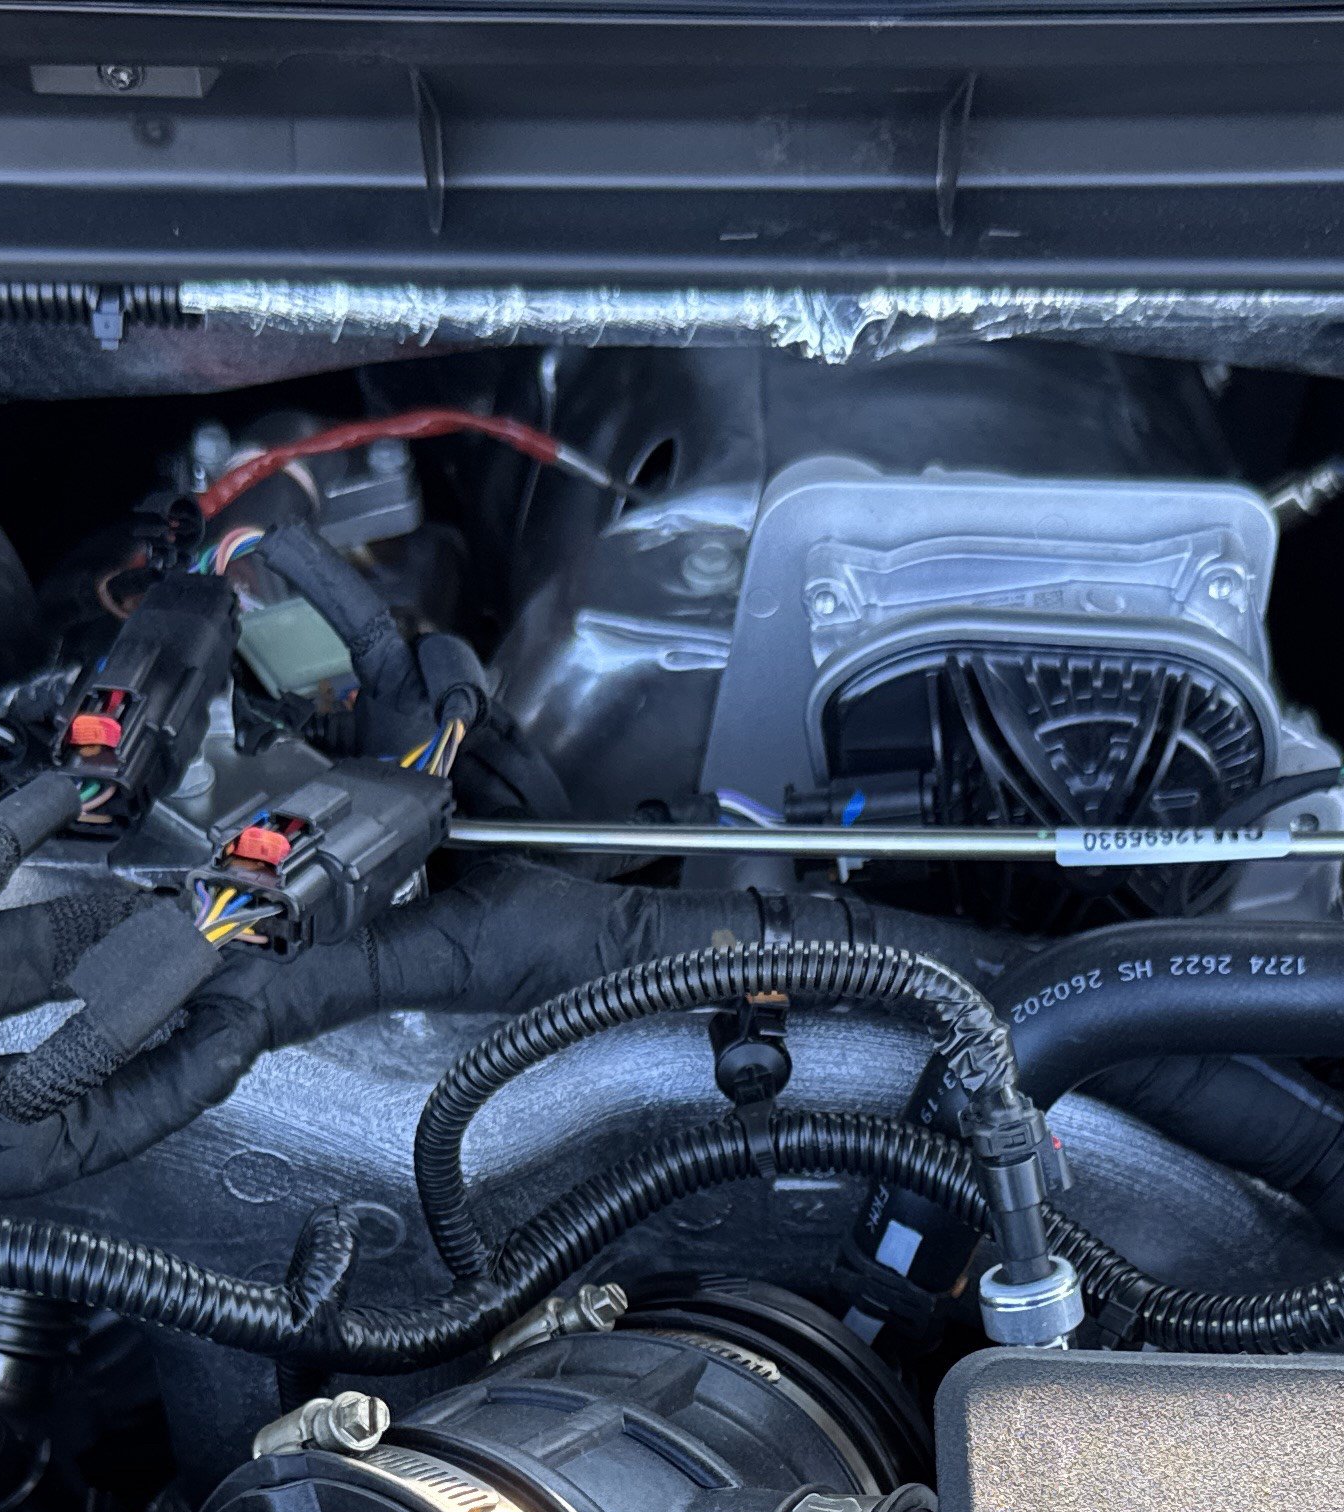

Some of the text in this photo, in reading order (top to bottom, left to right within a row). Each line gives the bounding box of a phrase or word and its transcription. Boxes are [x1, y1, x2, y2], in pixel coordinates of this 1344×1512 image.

[1010, 953, 1307, 1026] 1274 2622 HS 260202
